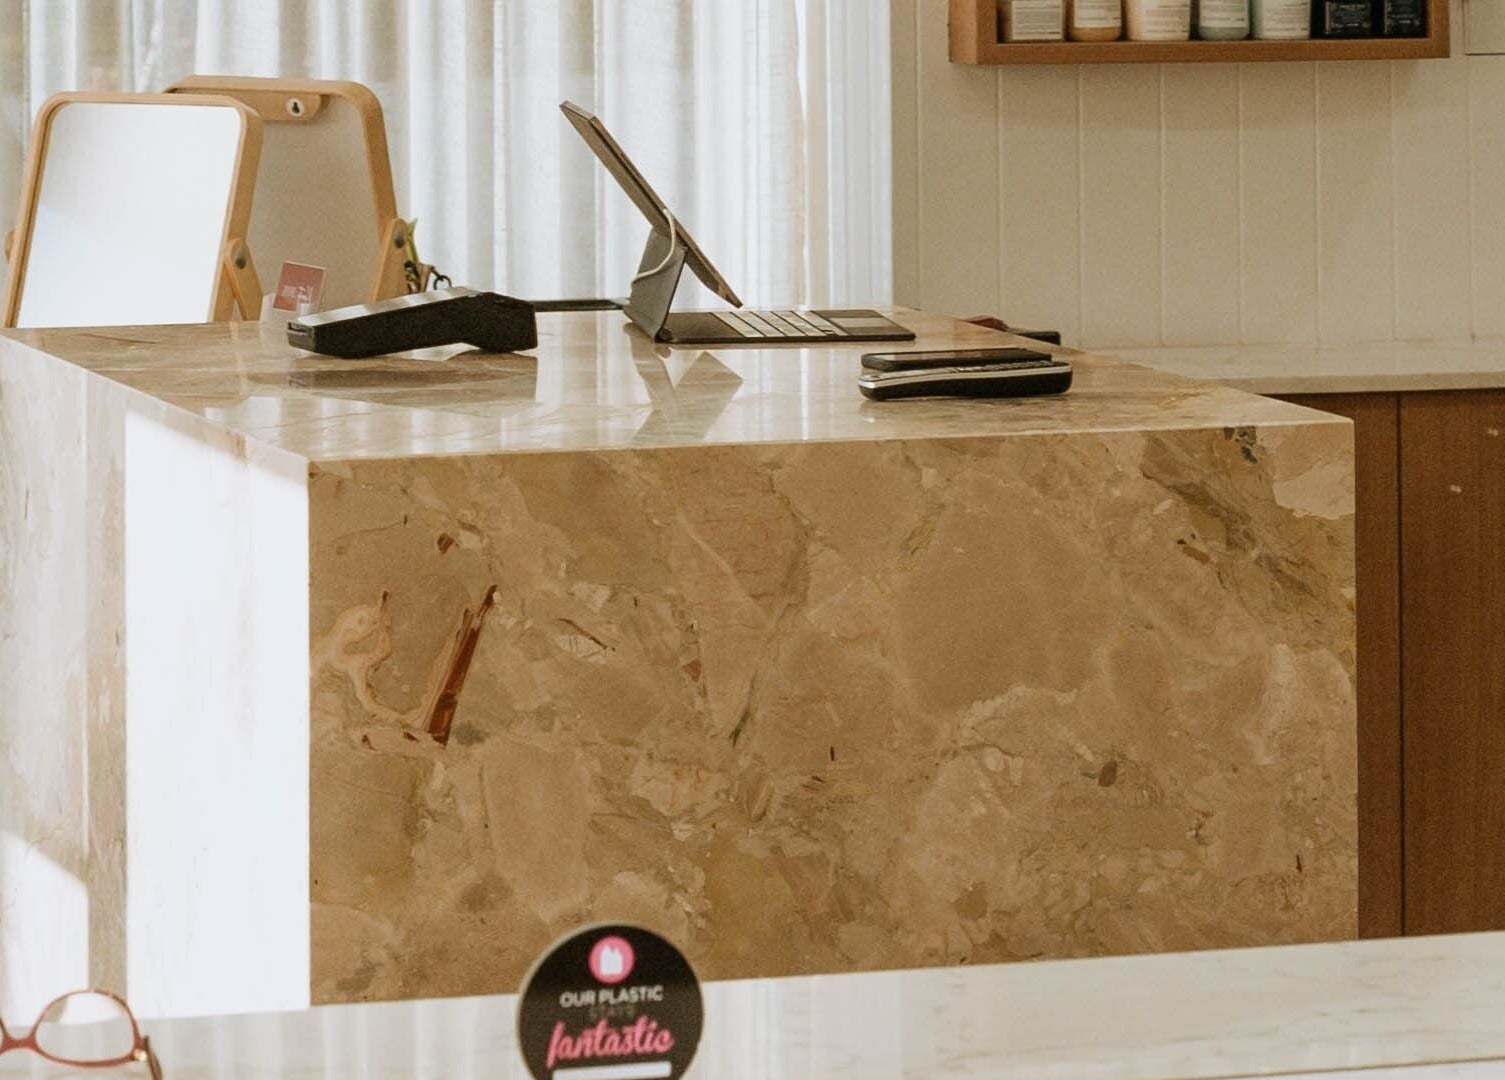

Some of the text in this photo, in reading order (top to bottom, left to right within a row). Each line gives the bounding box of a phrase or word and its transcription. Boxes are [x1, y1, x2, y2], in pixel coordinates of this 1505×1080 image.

[559, 985, 664, 1008] OUR PLASTIC
[547, 1015, 674, 1068] fantastic
